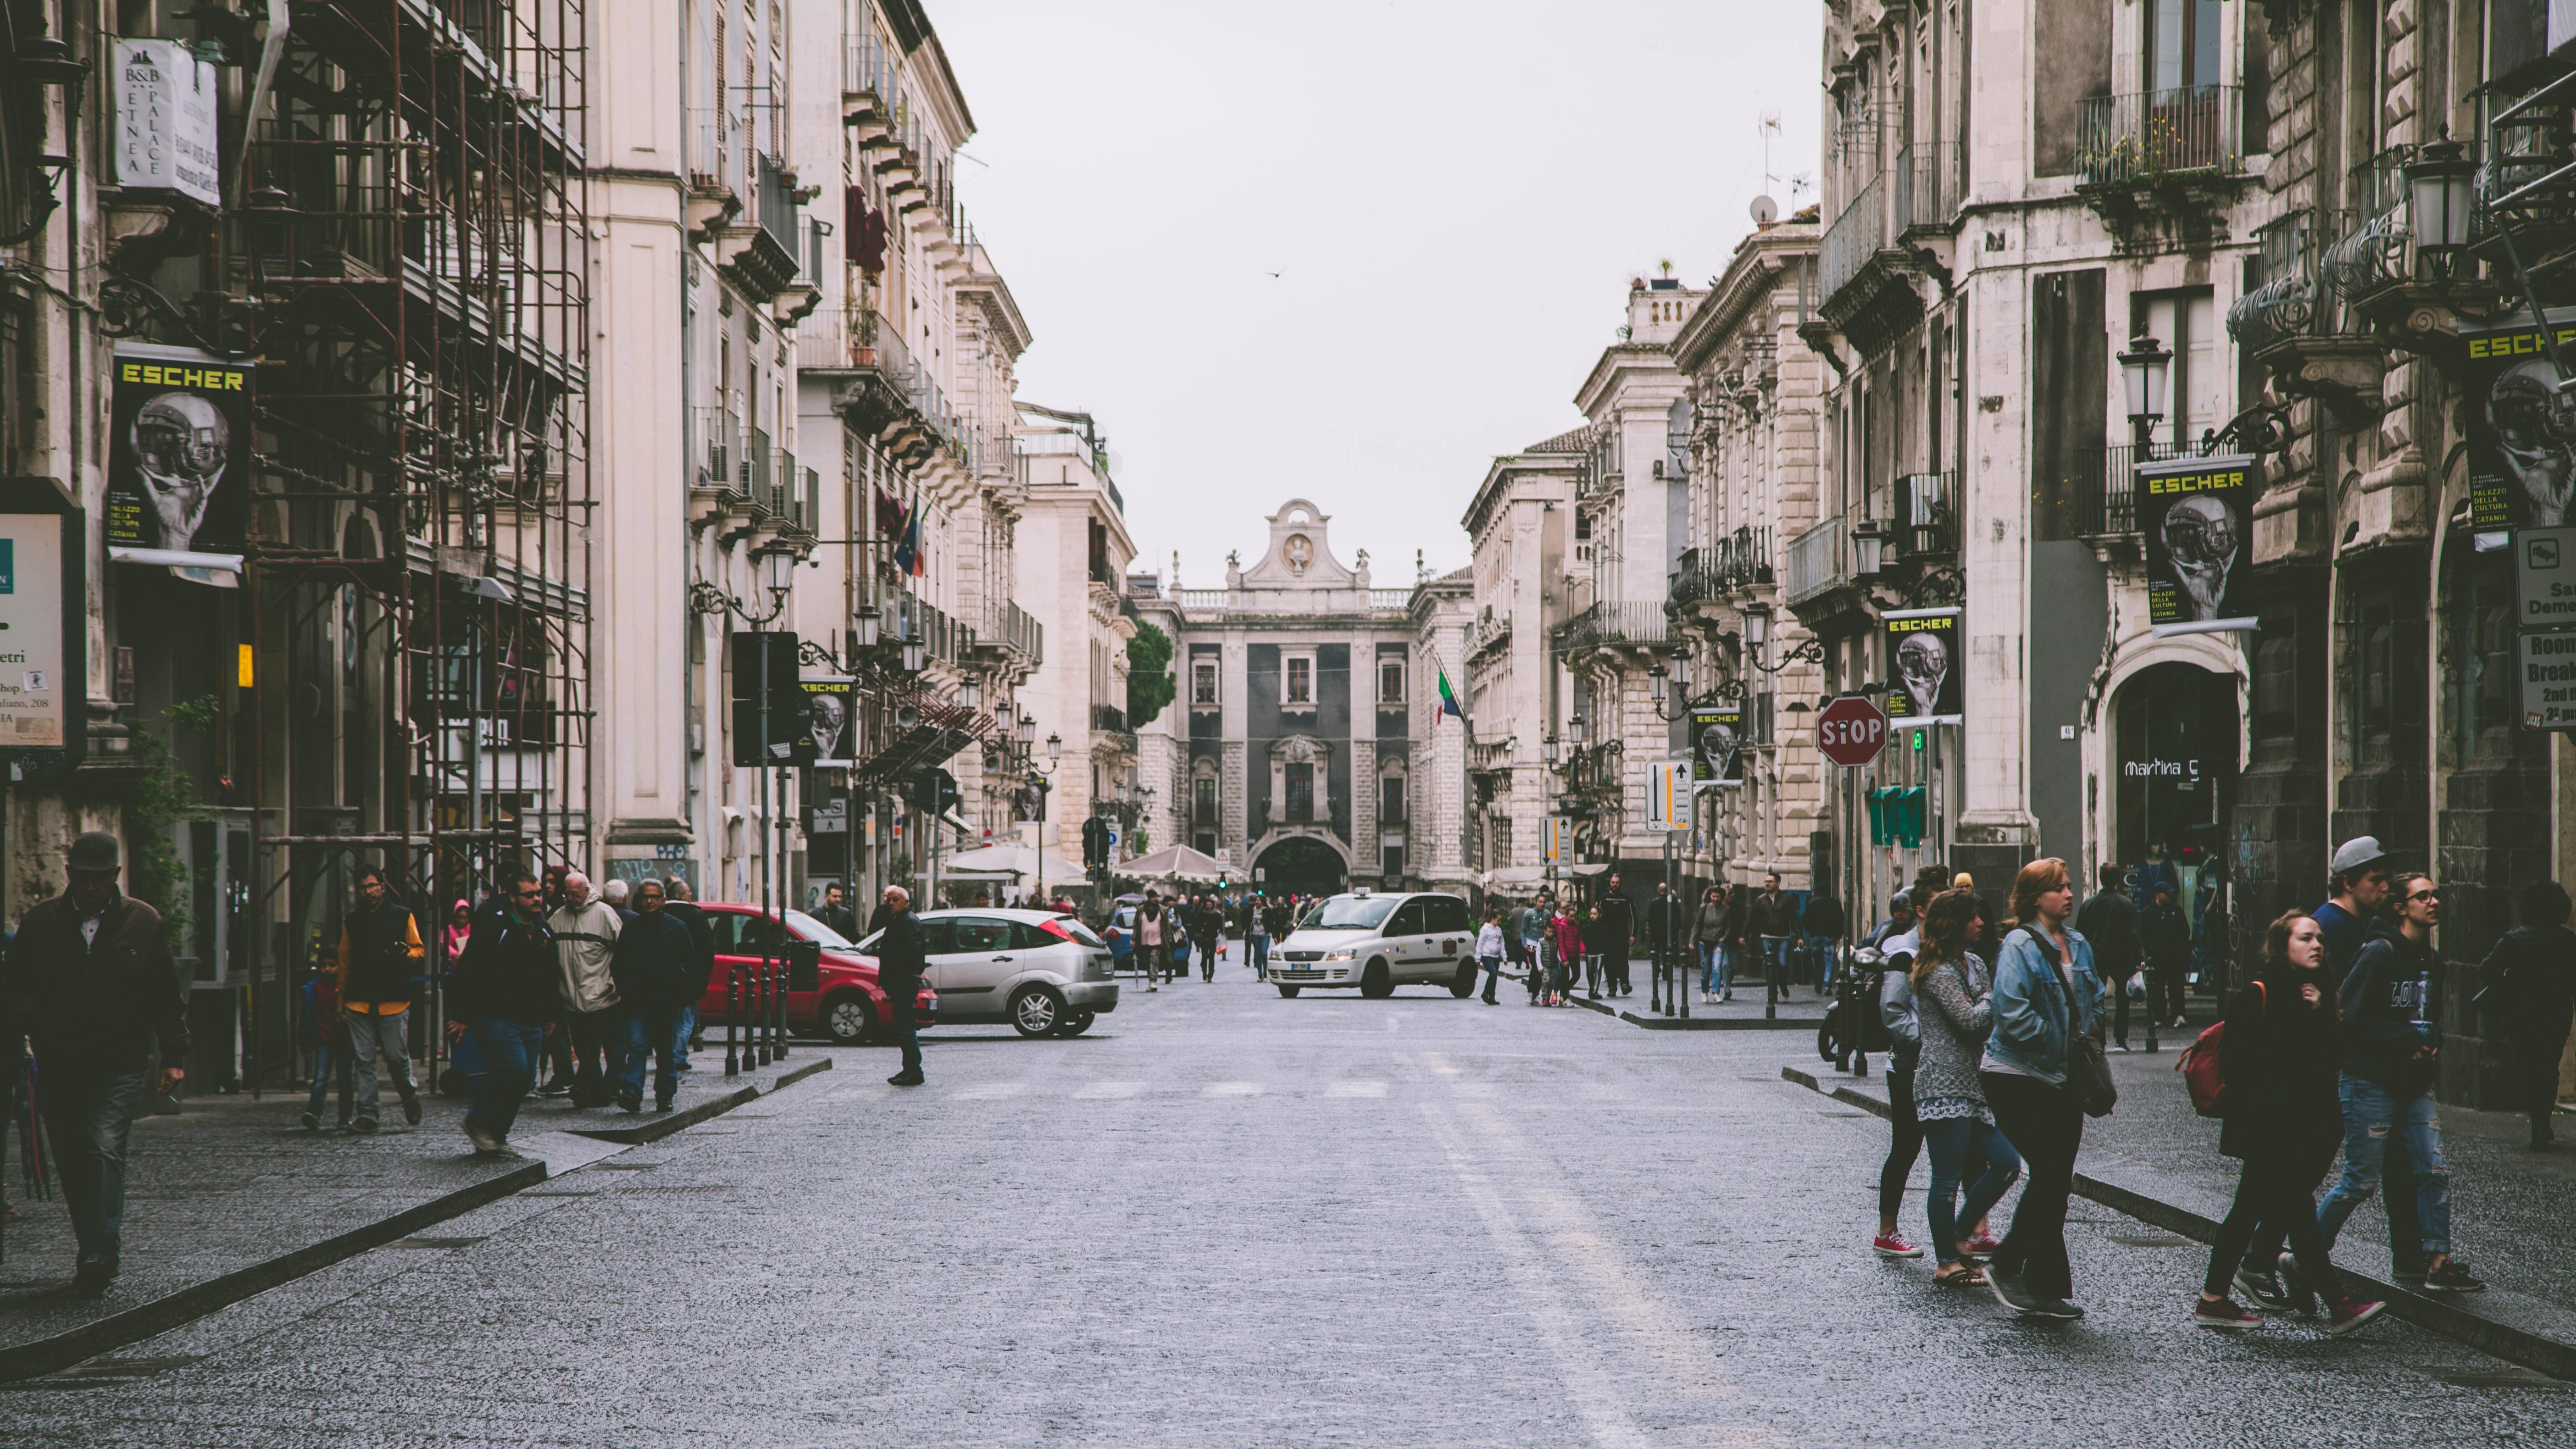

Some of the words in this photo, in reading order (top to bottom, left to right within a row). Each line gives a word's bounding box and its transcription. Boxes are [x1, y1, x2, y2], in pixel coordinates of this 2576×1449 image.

[126, 68, 160, 82] B&B
[127, 93, 139, 172] ETNEA
[148, 90, 160, 174] PALACE
[123, 364, 243, 390] ESCHER
[2150, 472, 2243, 494] ESCHER
[2474, 488, 2507, 496] PALAZZO
[2474, 496, 2498, 504] DELLA
[2475, 502, 2508, 511] CULTURA
[2476, 514, 2507, 523] CATANIA
[1889, 617, 1952, 632] ESCHER
[2543, 687, 2567, 702] 2nd
[30, 699, 49, 708] 208
[1697, 715, 1740, 723] ESCHER
[1821, 718, 1882, 745] STOP
